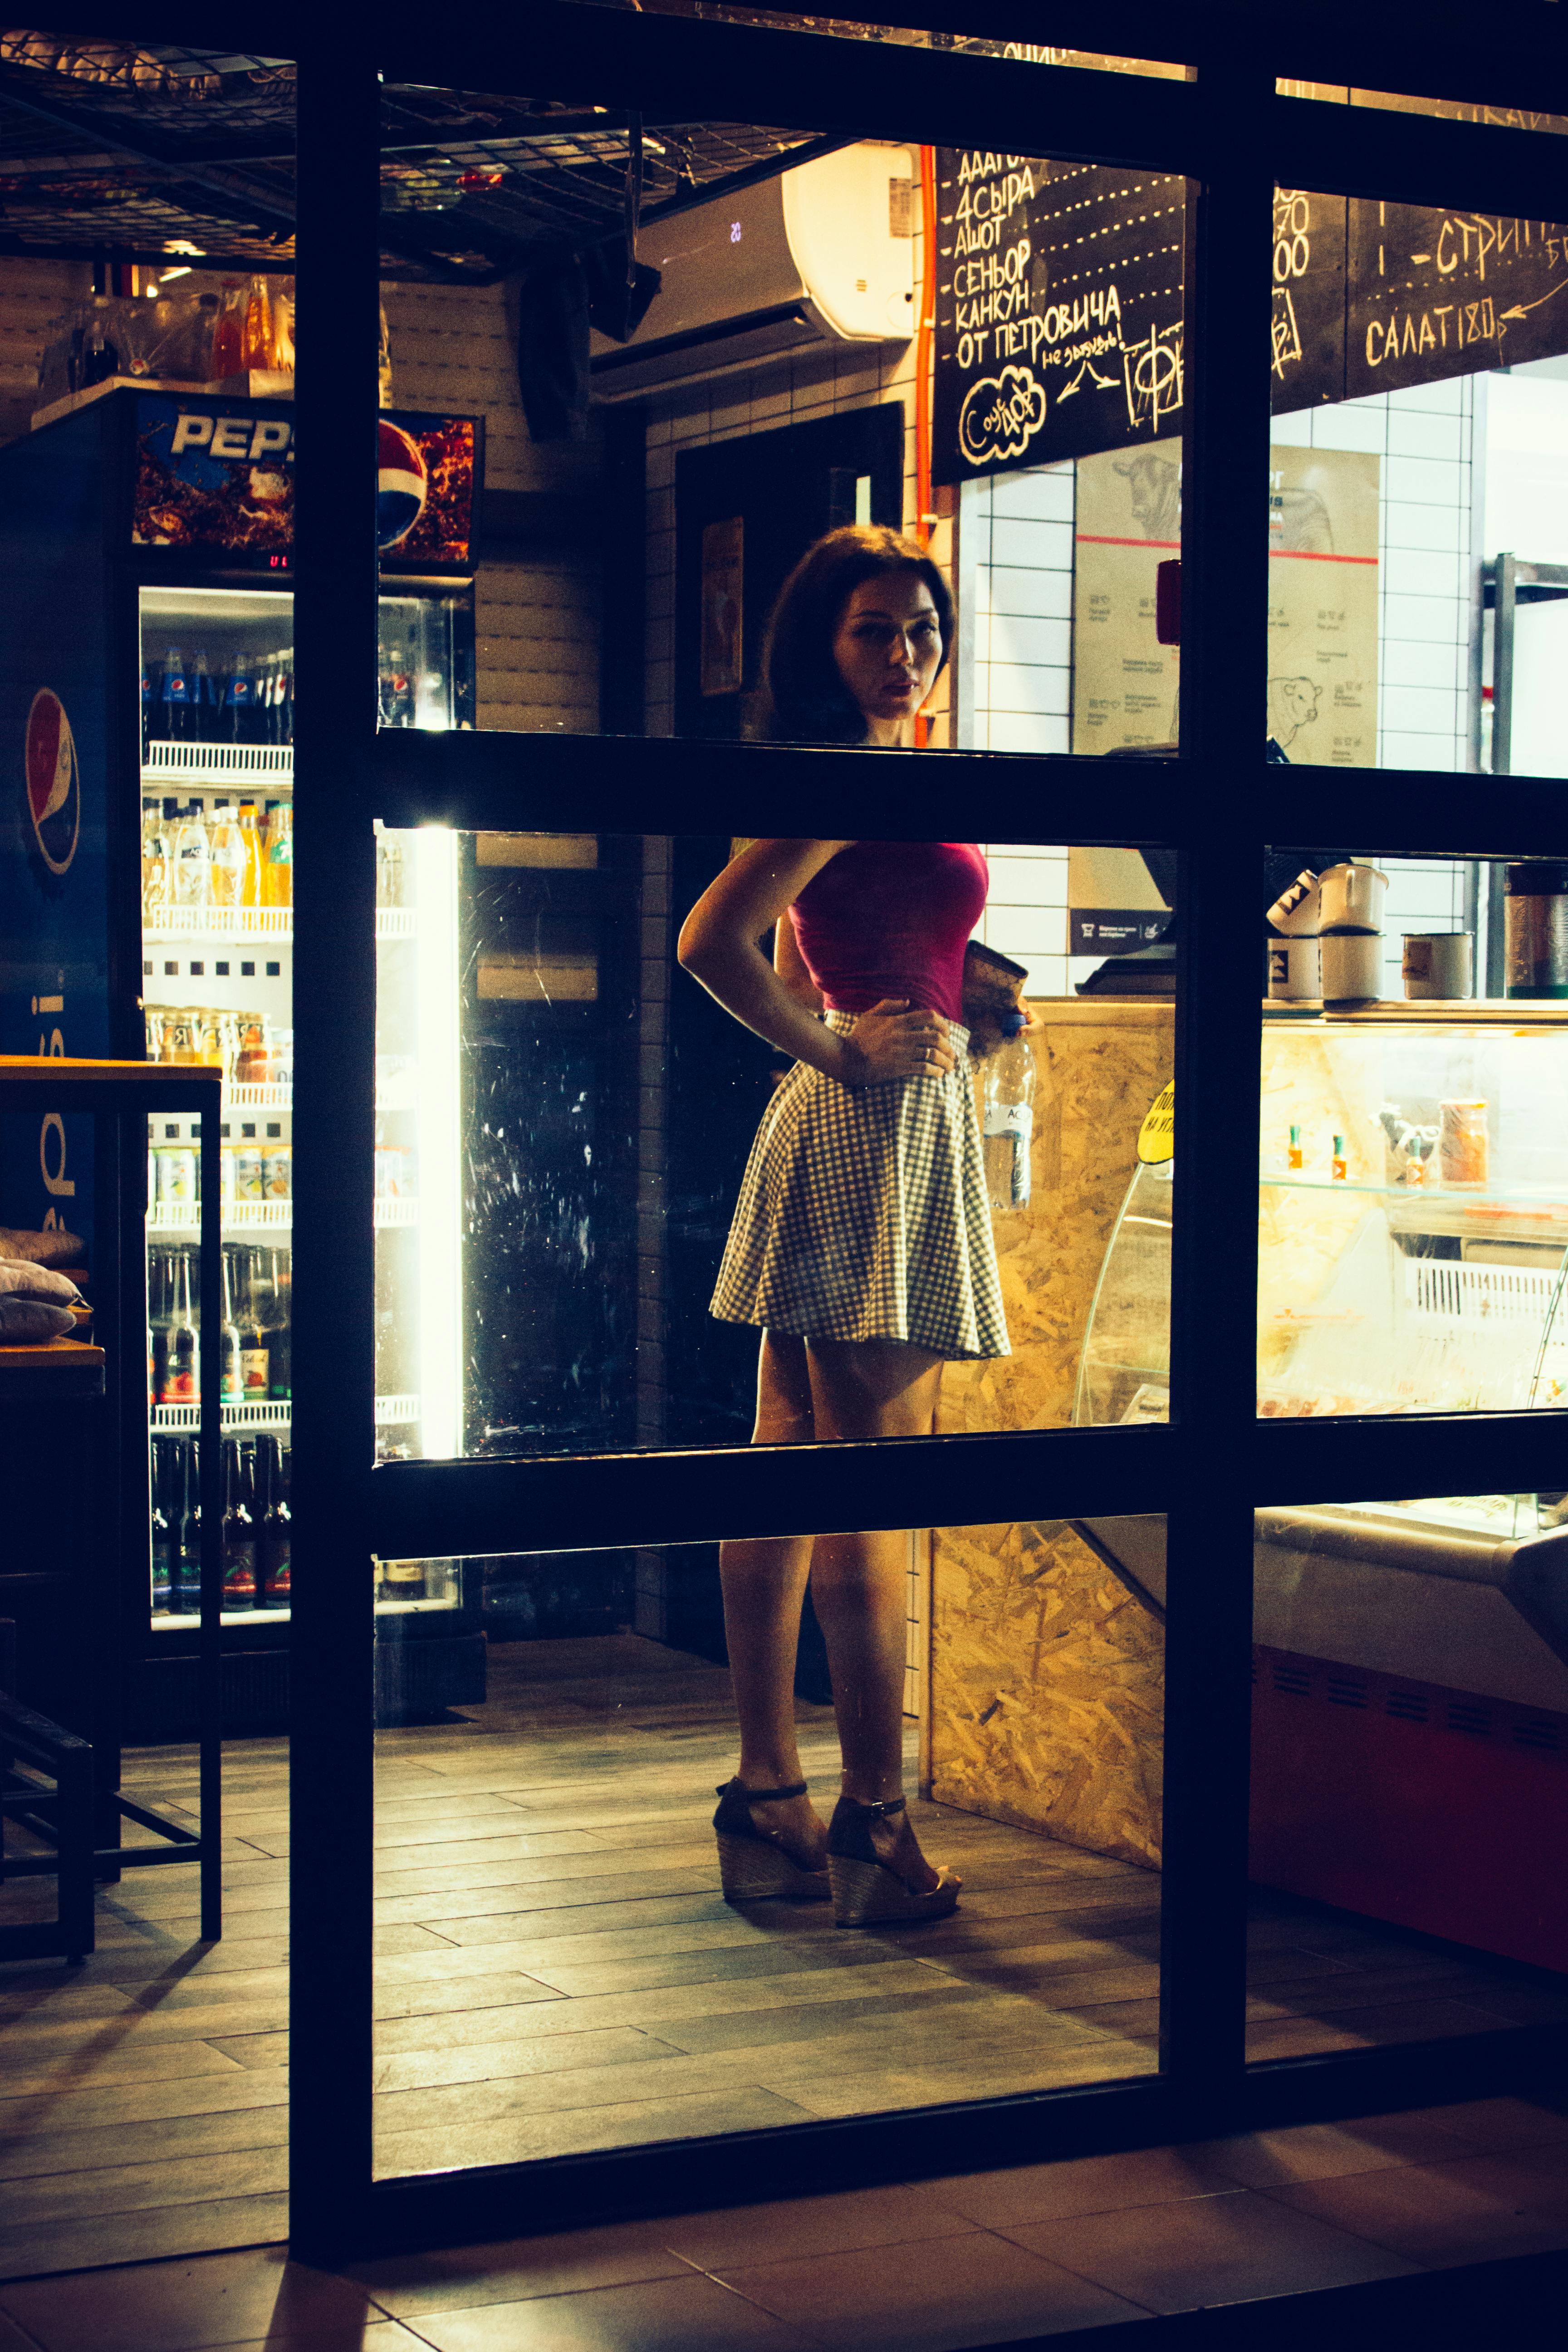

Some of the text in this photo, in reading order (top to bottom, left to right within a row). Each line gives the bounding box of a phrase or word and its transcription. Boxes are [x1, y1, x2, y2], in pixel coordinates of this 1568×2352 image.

[954, 214, 1006, 259] АШОТ
[953, 239, 1031, 298] СЕНЬОР
[956, 279, 1029, 334] КАНКУН
[957, 284, 1121, 369] ОТ ПЕТРОВИЧА
[1366, 305, 1453, 367] САЛАТ
[170, 413, 294, 462] PEP
